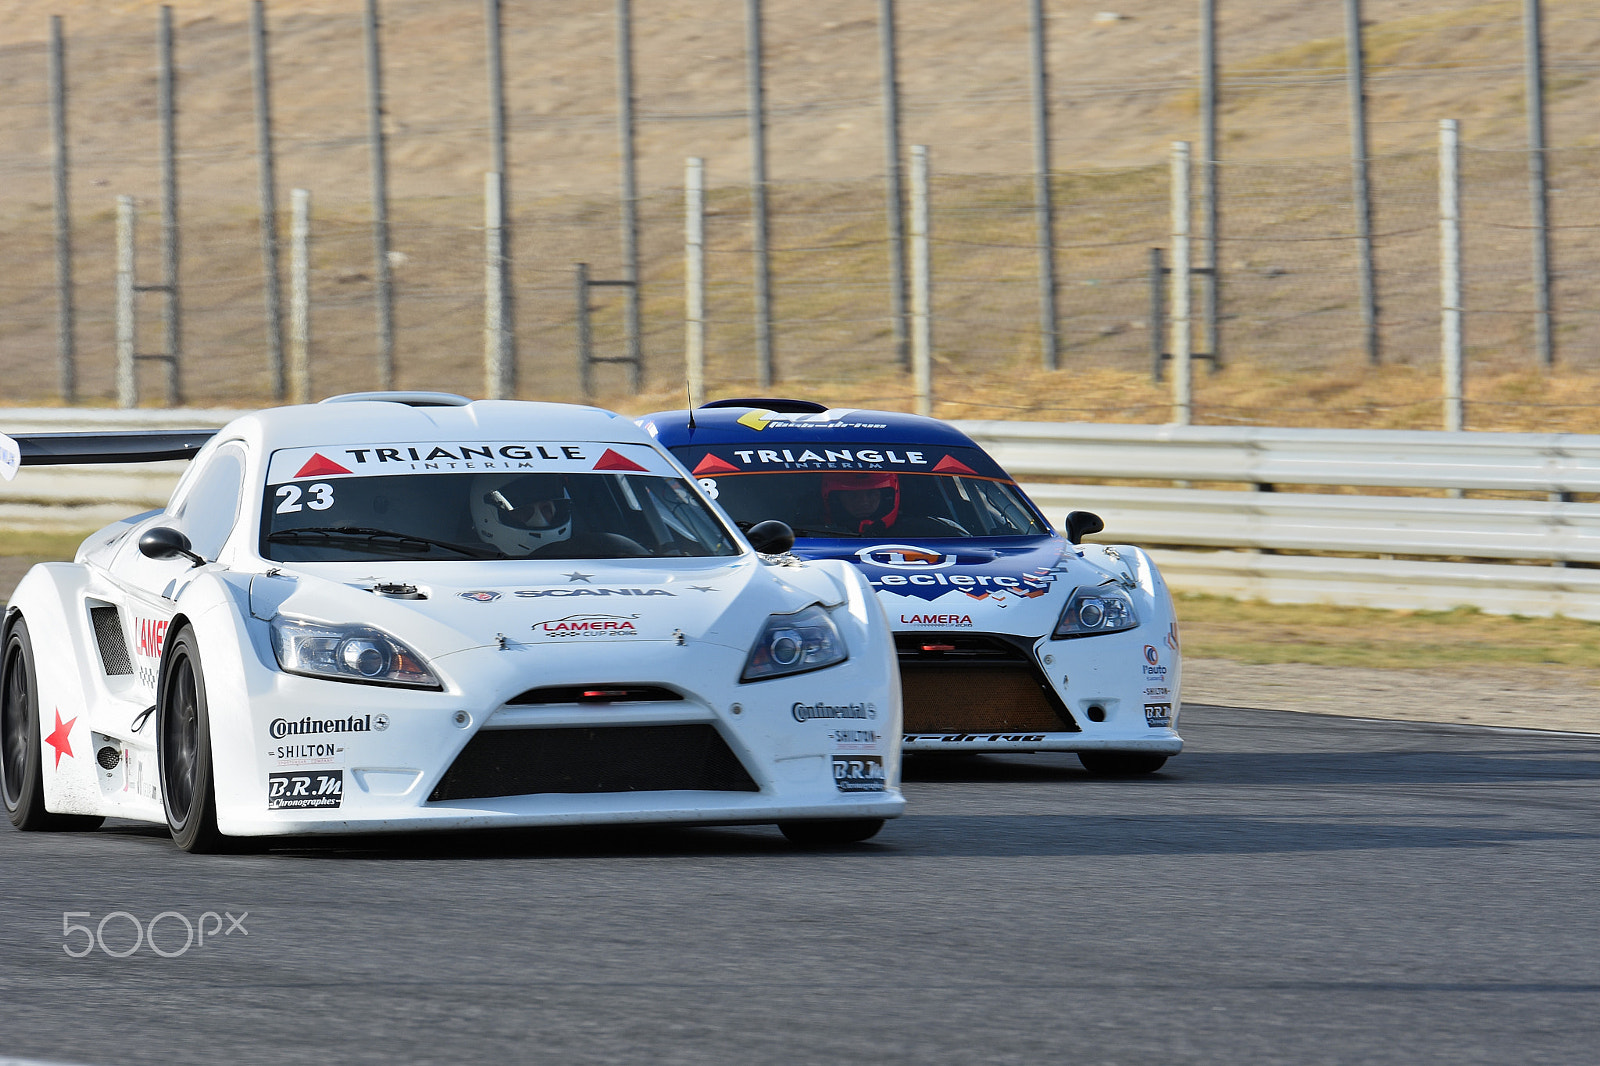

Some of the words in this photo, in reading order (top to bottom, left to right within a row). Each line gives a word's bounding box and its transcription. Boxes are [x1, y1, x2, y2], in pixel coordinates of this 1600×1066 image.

[345, 445, 586, 464] TRIANGLE
[733, 449, 928, 466] TRIANGLE
[410, 461, 534, 471] INTERIM
[275, 483, 335, 514] 23
[513, 588, 678, 598] SCANIA
[900, 614, 973, 624] LAMERA
[543, 621, 636, 632] LAMERA
[269, 714, 371, 740] Continental
[277, 743, 335, 759] SHILTON
[272, 796, 336, 809] Chronographes
